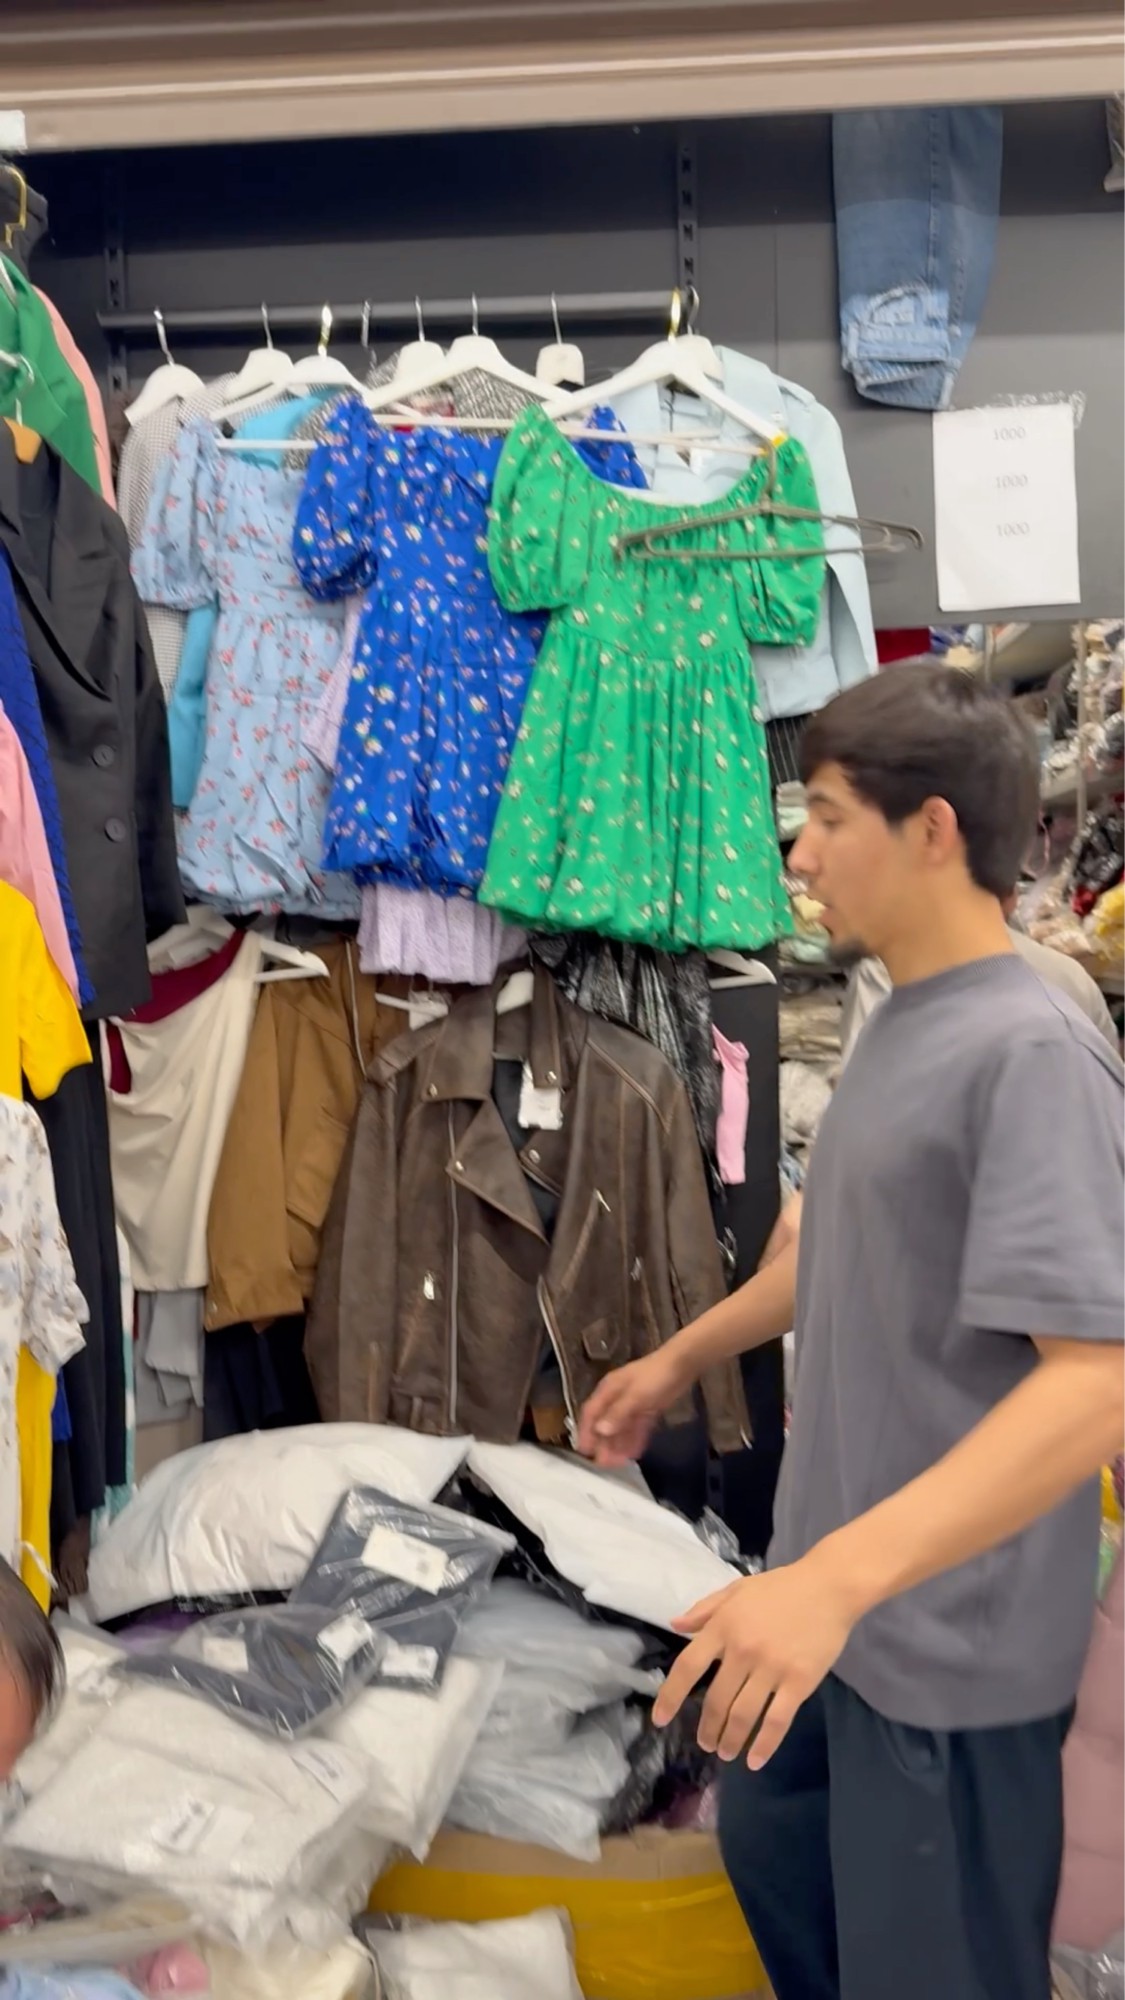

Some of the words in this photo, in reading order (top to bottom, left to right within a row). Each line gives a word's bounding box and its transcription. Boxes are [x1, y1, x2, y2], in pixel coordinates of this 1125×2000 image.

[994, 426, 1026, 440] 1000
[996, 474, 1028, 488] 1000
[996, 521, 1030, 536] 1000
